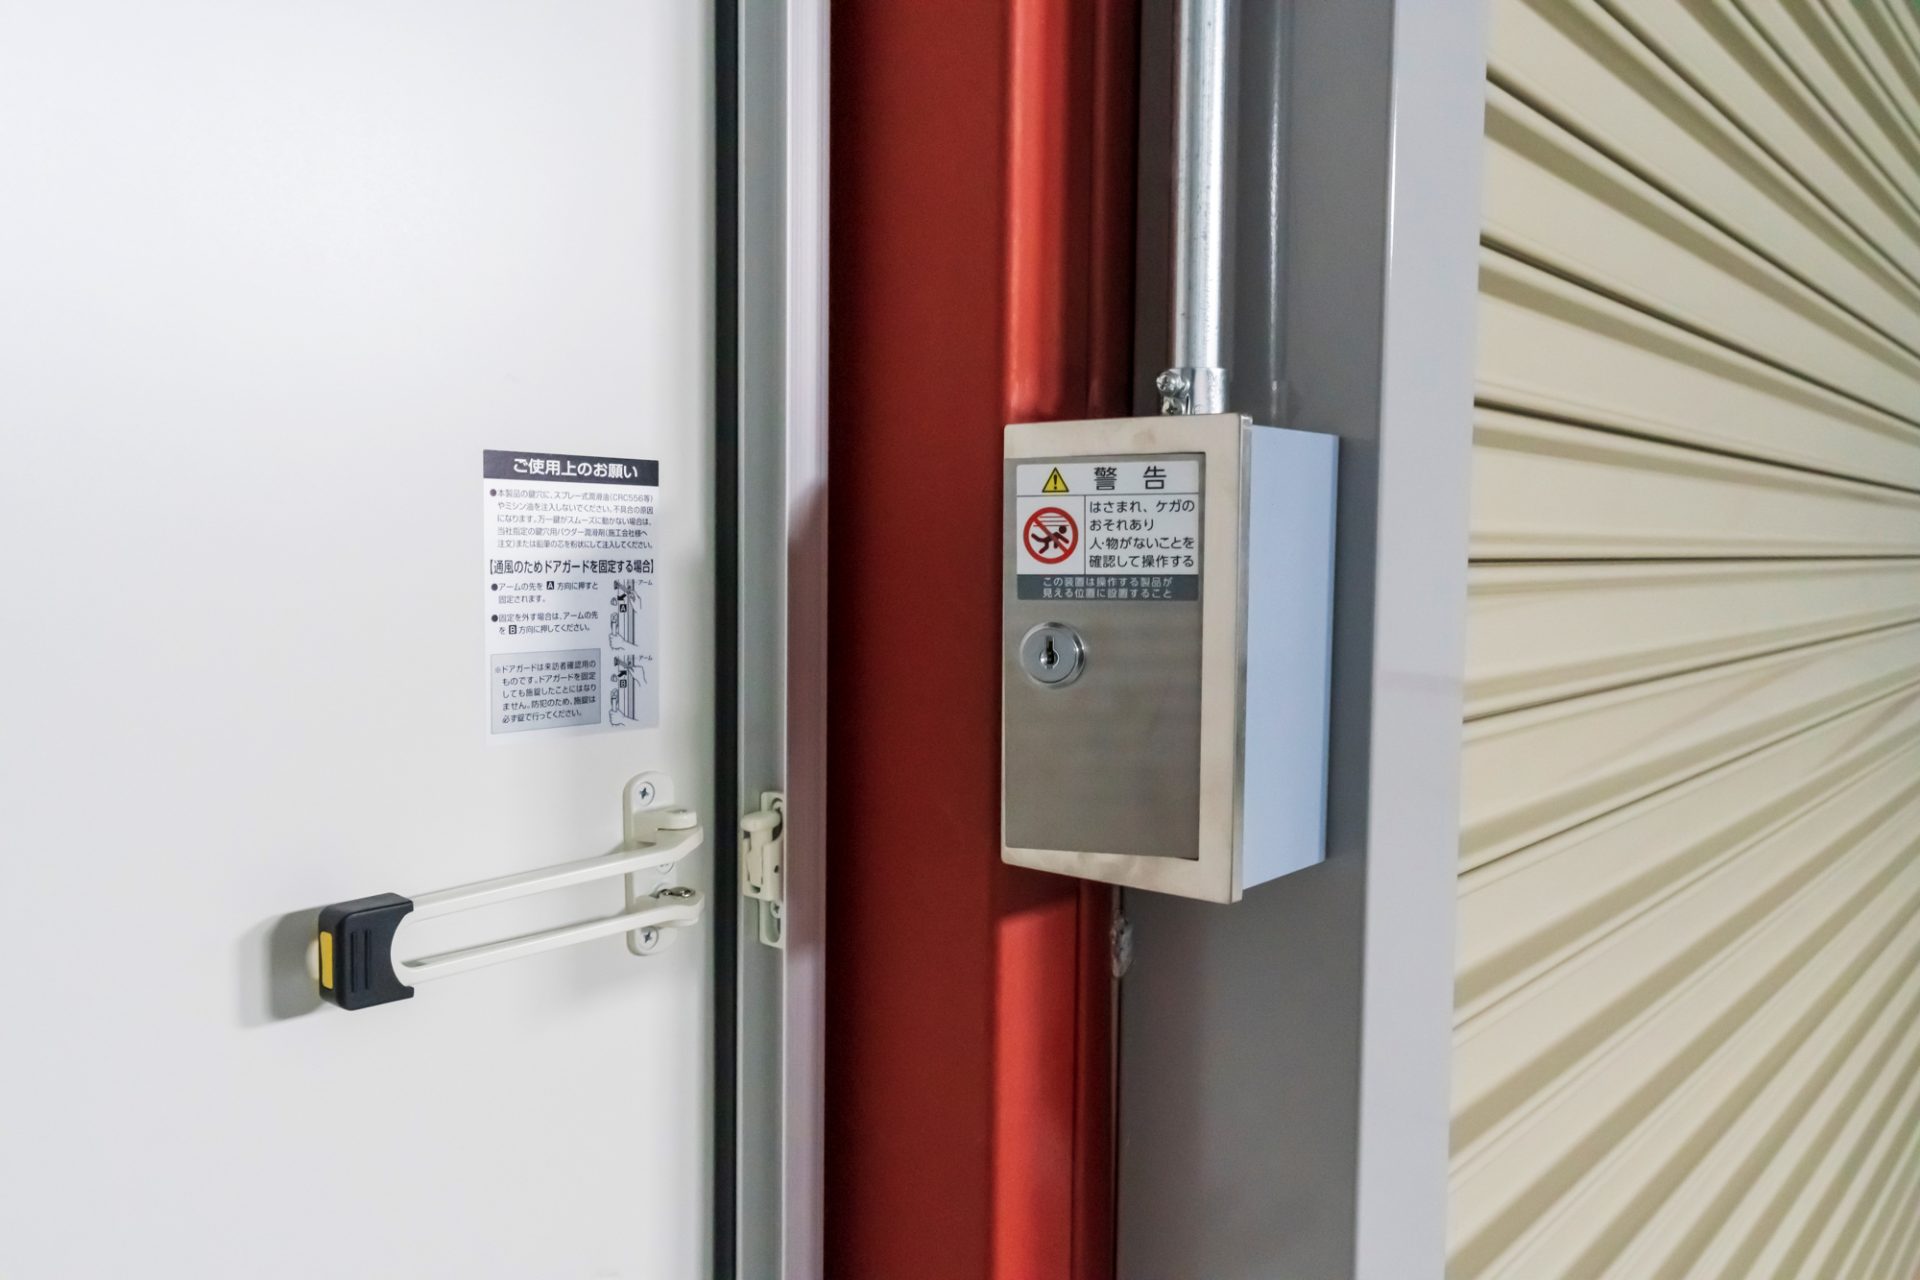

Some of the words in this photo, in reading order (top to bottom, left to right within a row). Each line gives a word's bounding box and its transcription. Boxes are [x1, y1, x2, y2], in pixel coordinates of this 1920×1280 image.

[513, 458, 638, 479] ご使用上のお願い
[1089, 499, 1195, 513] はさまれ、ケガの
[1089, 518, 1154, 531] おそれあり
[1089, 555, 1195, 568] 確認して操作する
[1042, 577, 1173, 588] この装置は操作する製品が
[498, 595, 546, 604] 固定されます。
[1042, 588, 1173, 599] 見える位置に設置すること
